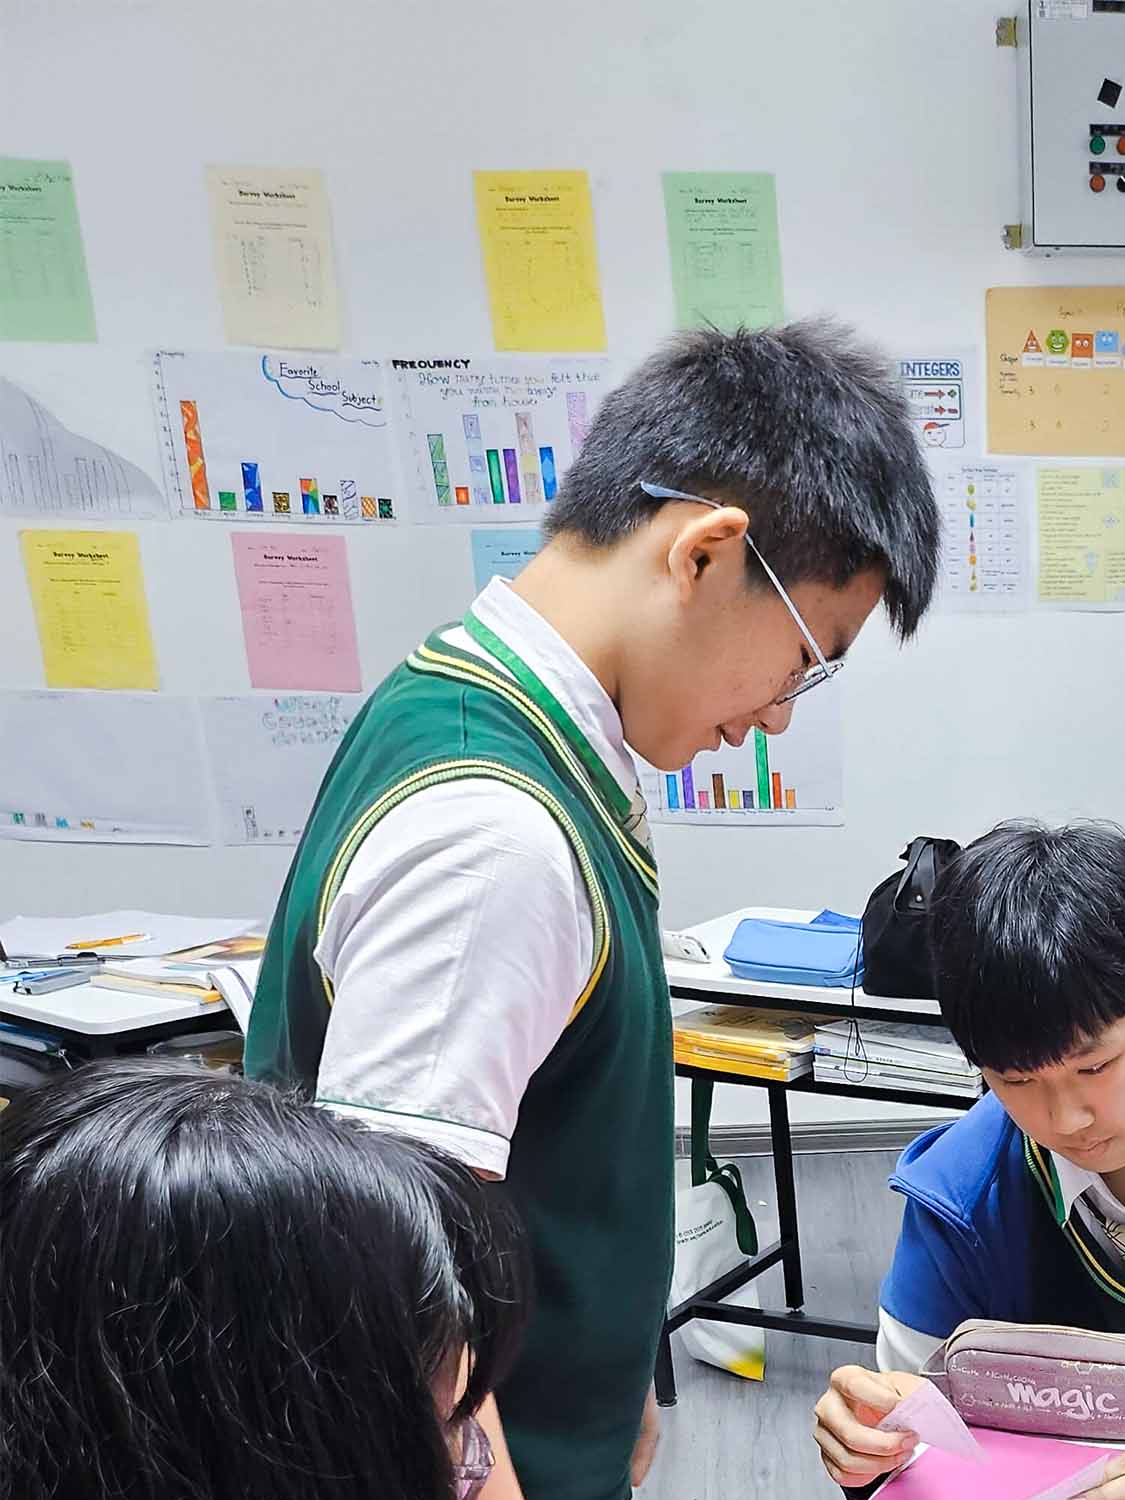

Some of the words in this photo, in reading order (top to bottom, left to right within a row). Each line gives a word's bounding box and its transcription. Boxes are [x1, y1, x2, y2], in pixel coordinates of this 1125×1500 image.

[901, 362, 960, 376] INTEGERS
[308, 380, 340, 392] School
[342, 390, 382, 406] Subject
